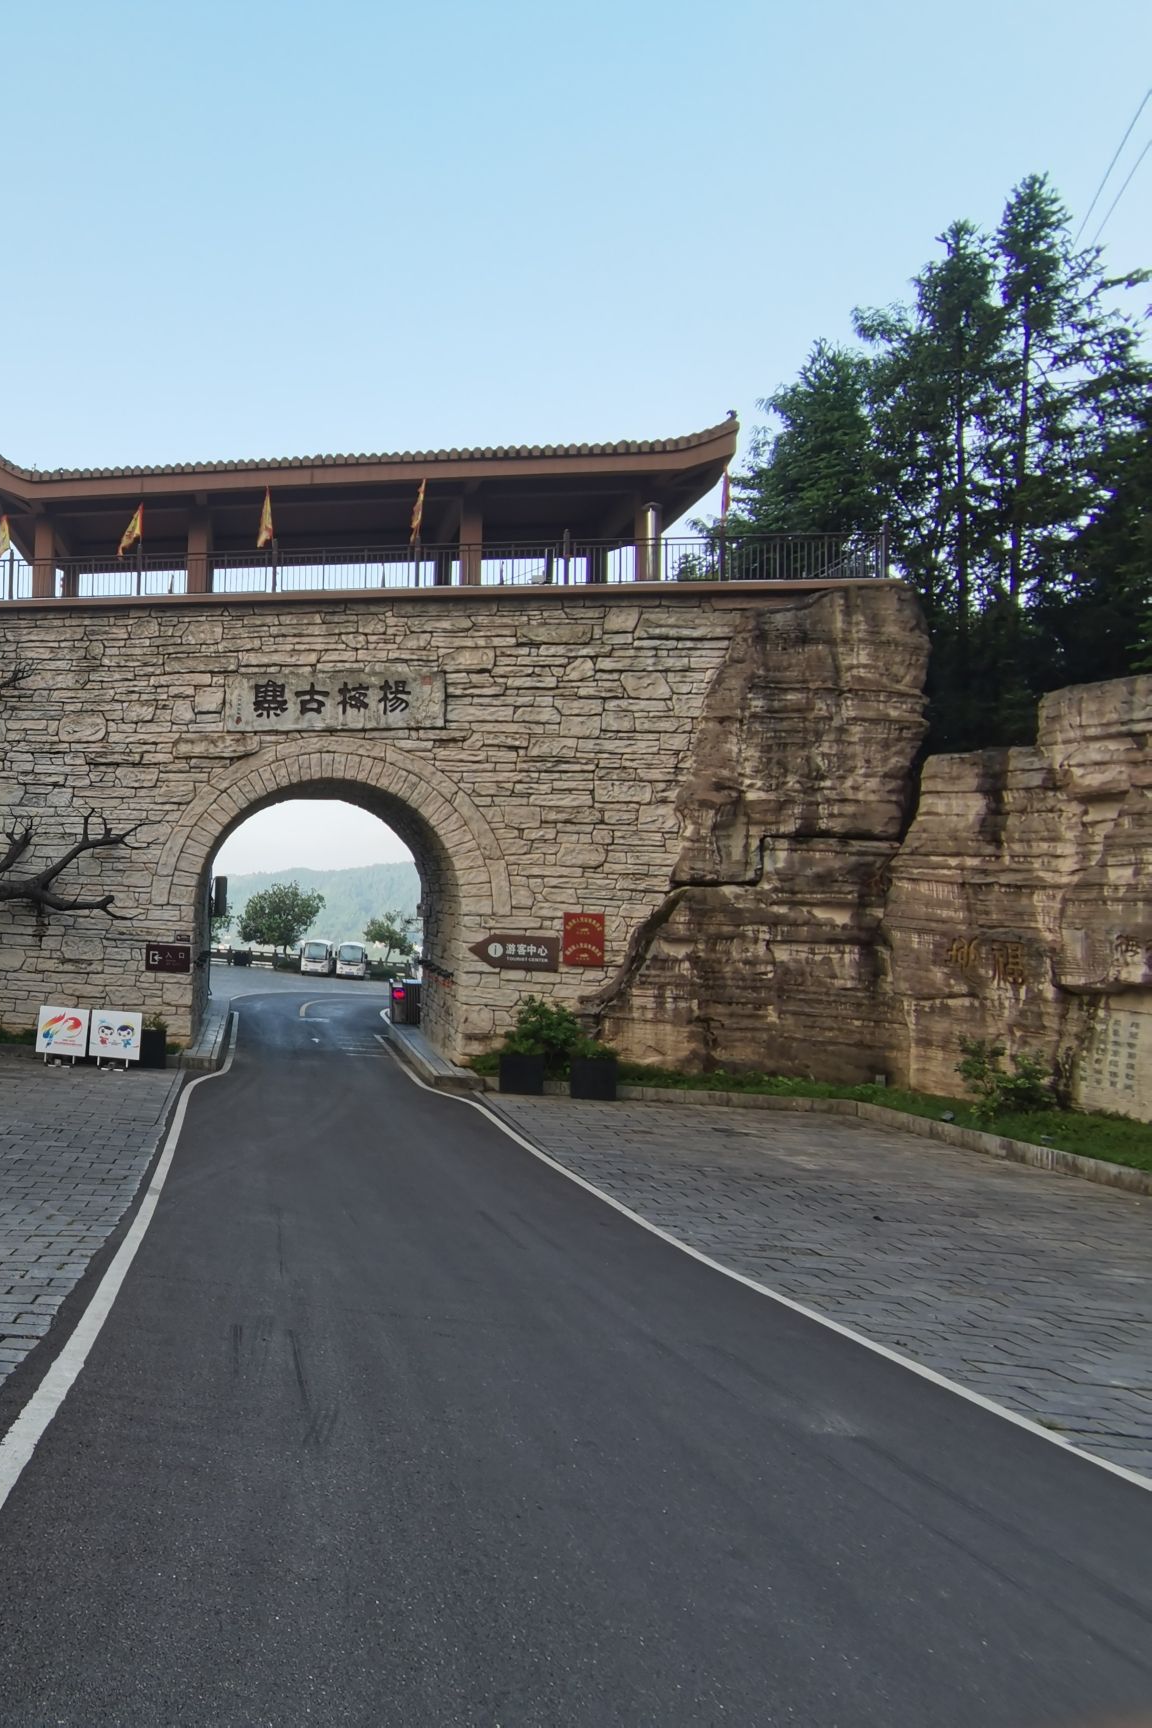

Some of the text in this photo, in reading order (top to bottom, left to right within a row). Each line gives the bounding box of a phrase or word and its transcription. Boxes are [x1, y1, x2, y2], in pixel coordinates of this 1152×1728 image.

[505, 943, 548, 956] 游客中心
[164, 951, 186, 960] 入口
